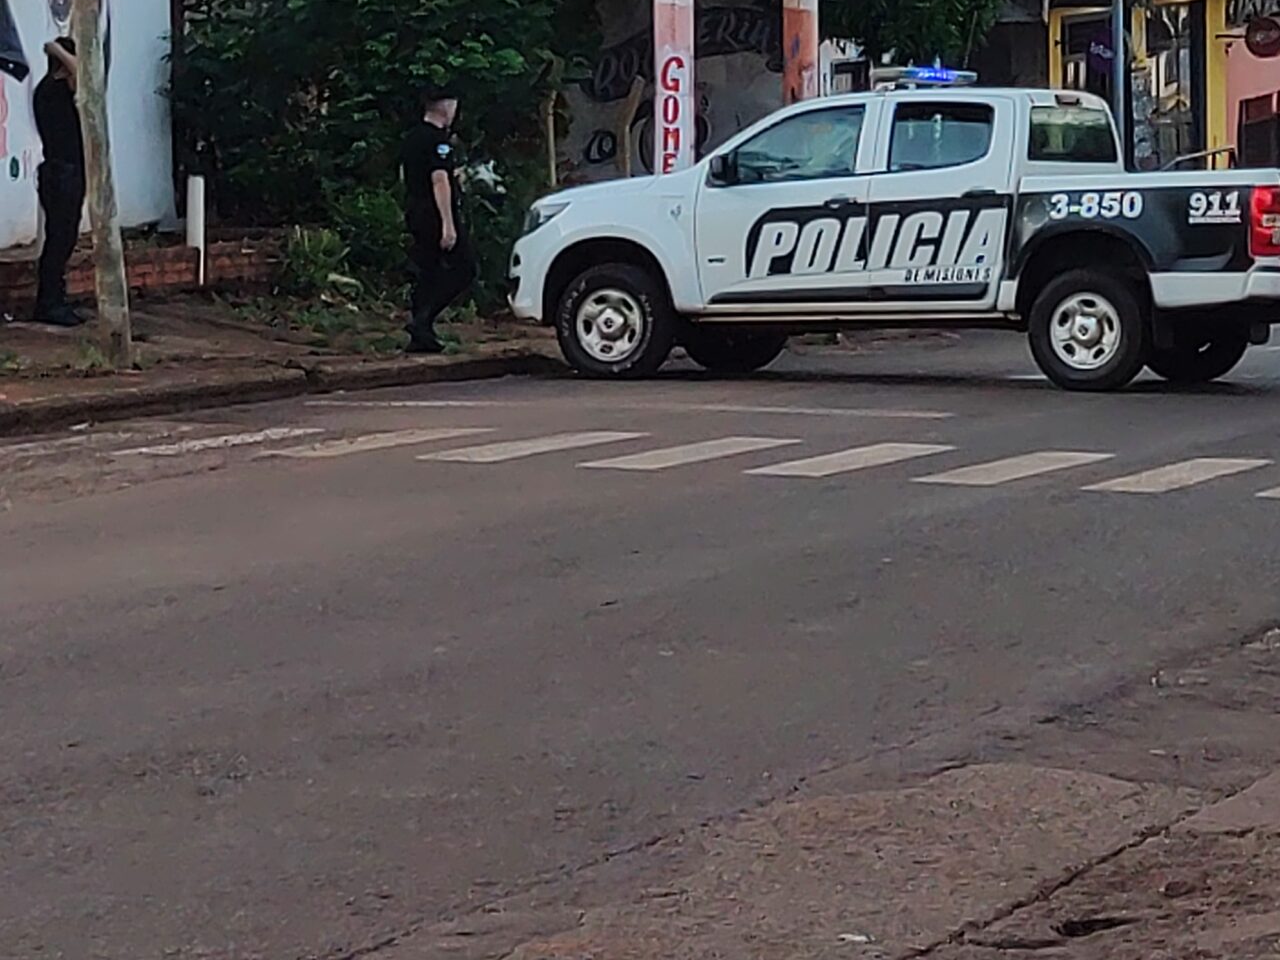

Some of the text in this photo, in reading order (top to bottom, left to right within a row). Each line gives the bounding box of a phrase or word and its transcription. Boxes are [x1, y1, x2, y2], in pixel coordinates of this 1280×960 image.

[1050, 192, 1143, 219] 3-850
[1189, 191, 1241, 217] 911
[750, 207, 1006, 278] POLICIA
